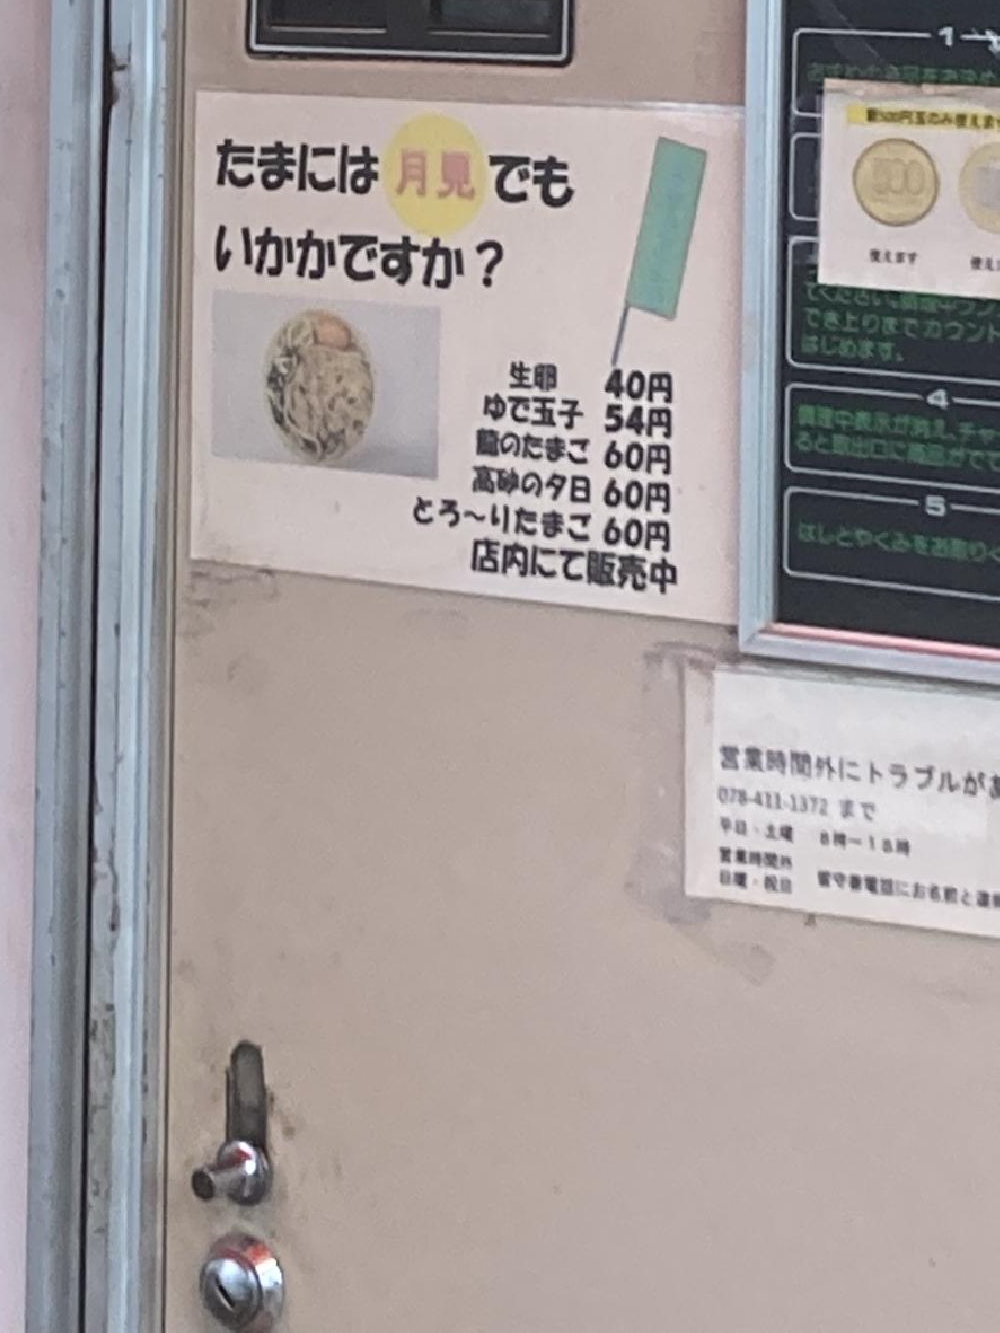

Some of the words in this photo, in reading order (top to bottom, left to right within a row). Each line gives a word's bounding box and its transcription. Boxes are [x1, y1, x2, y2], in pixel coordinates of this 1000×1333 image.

[604, 369, 673, 403] 40円
[926, 387, 949, 410] 4
[484, 395, 583, 429] ゆで玉子
[604, 405, 672, 438] 54円
[604, 440, 672, 475] 60円
[472, 466, 592, 504] 高砂の夕日
[603, 478, 672, 513] 60円
[924, 494, 947, 518] 5
[603, 517, 671, 552] 60円
[471, 538, 678, 594] 店内にて販売中
